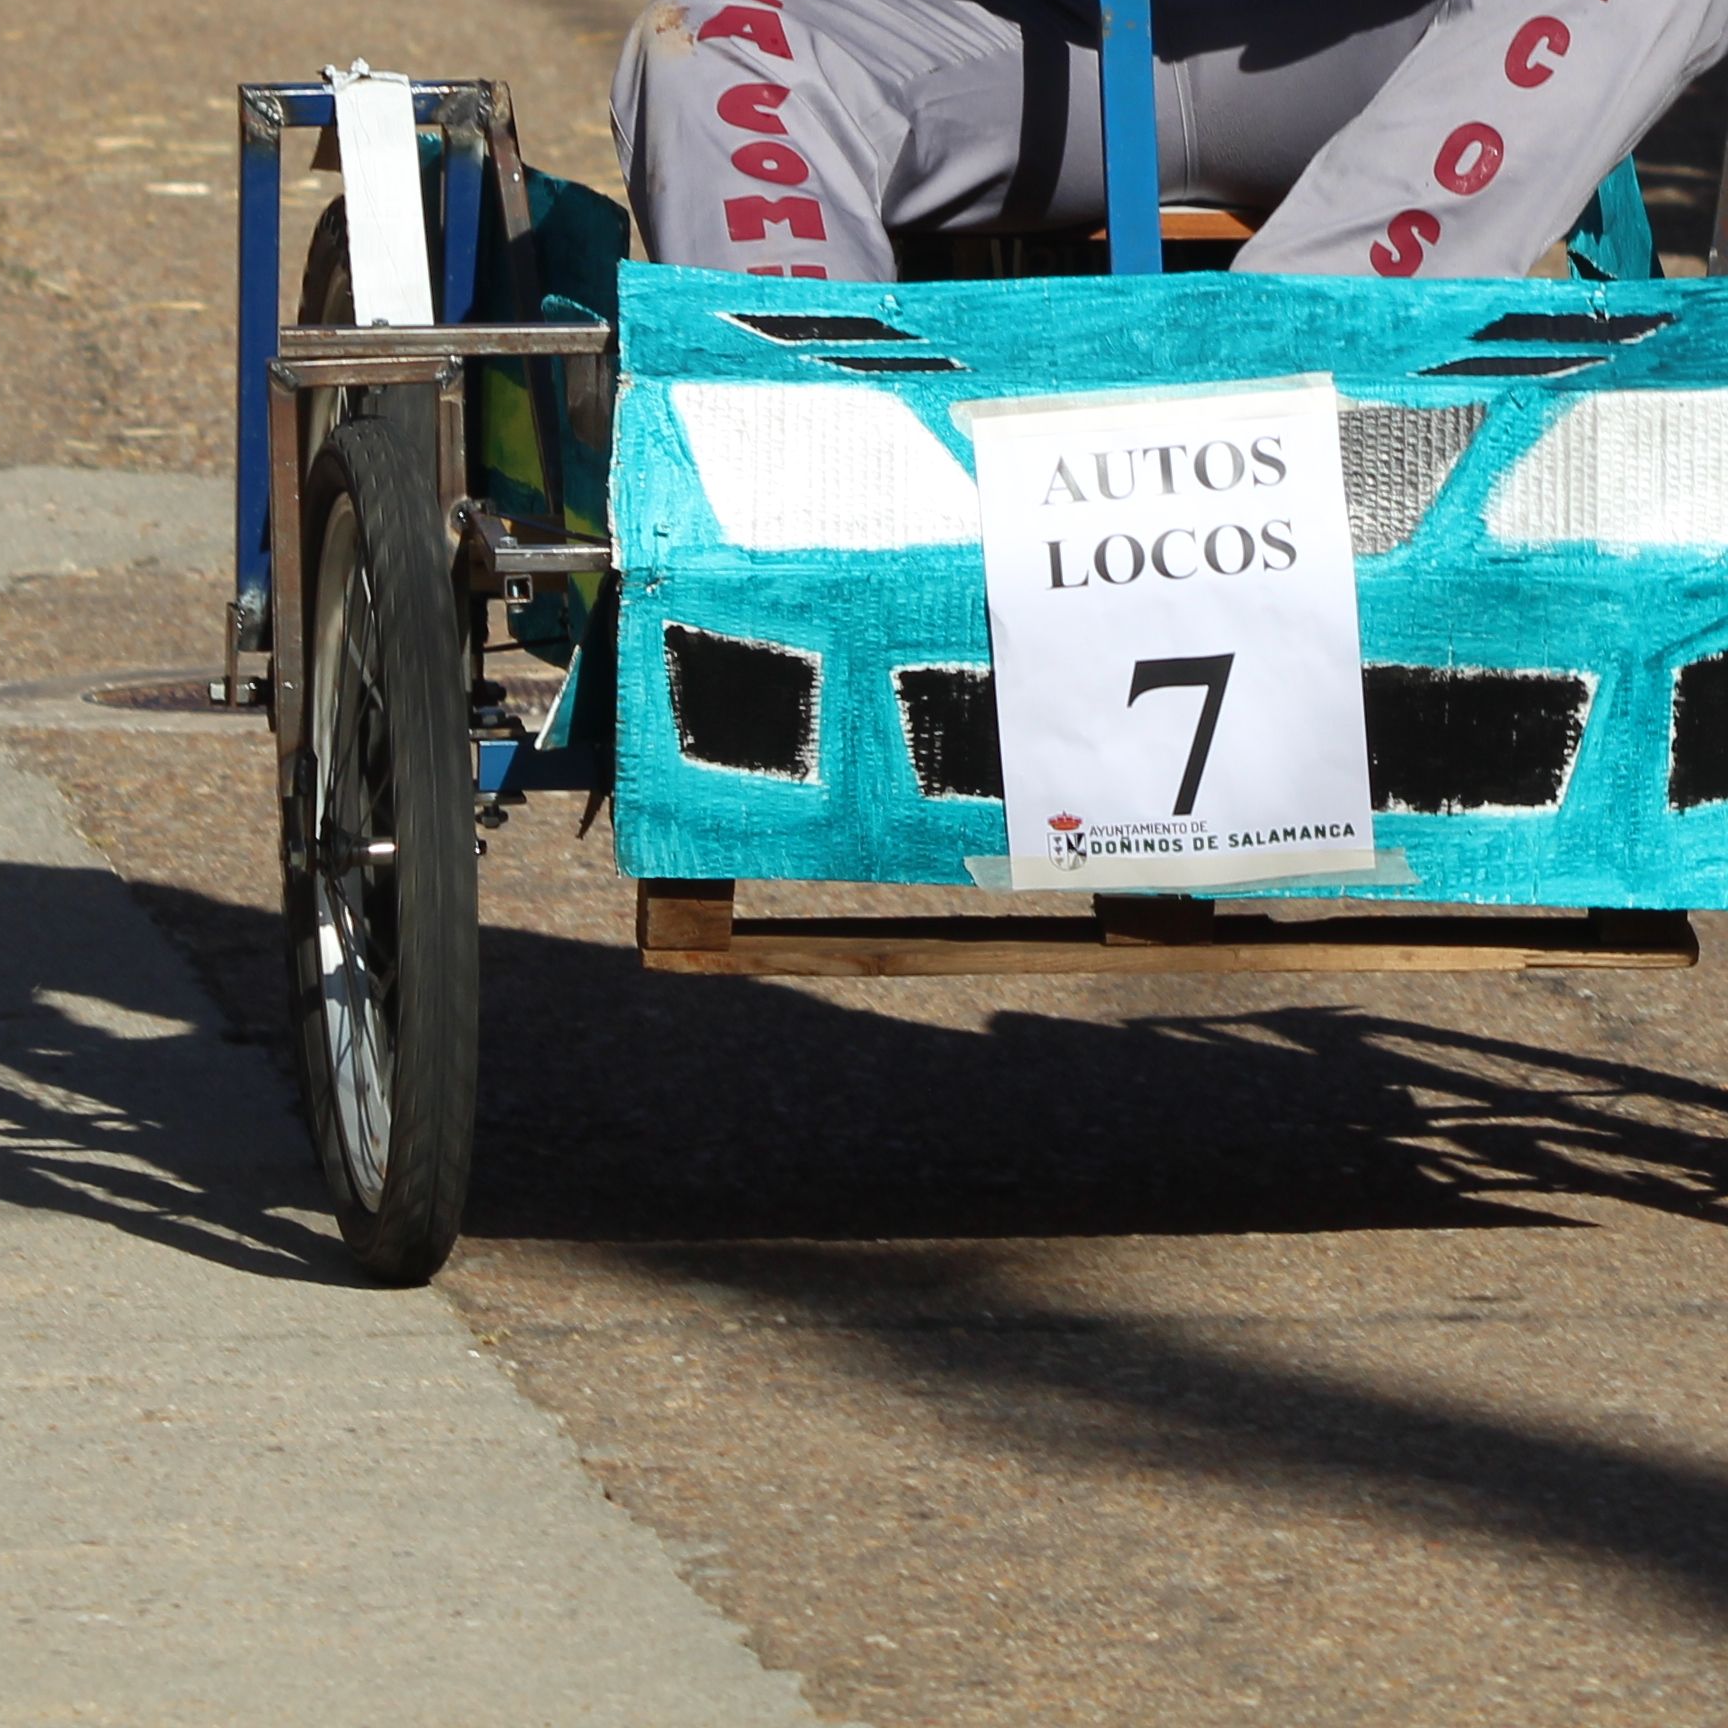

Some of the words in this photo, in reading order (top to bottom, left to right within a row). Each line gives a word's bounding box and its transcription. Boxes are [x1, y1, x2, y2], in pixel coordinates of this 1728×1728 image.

[1040, 435, 1288, 507] AUTOS
[1043, 518, 1298, 591] LOCOS
[1126, 652, 1236, 816] 7
[1089, 822, 1187, 838] AYUNTAMIENTO
[1191, 821, 1209, 834] DE
[1090, 834, 1184, 855] DOÑINOS
[1192, 835, 1219, 852] DE
[1227, 822, 1356, 849] SALAMANCA
